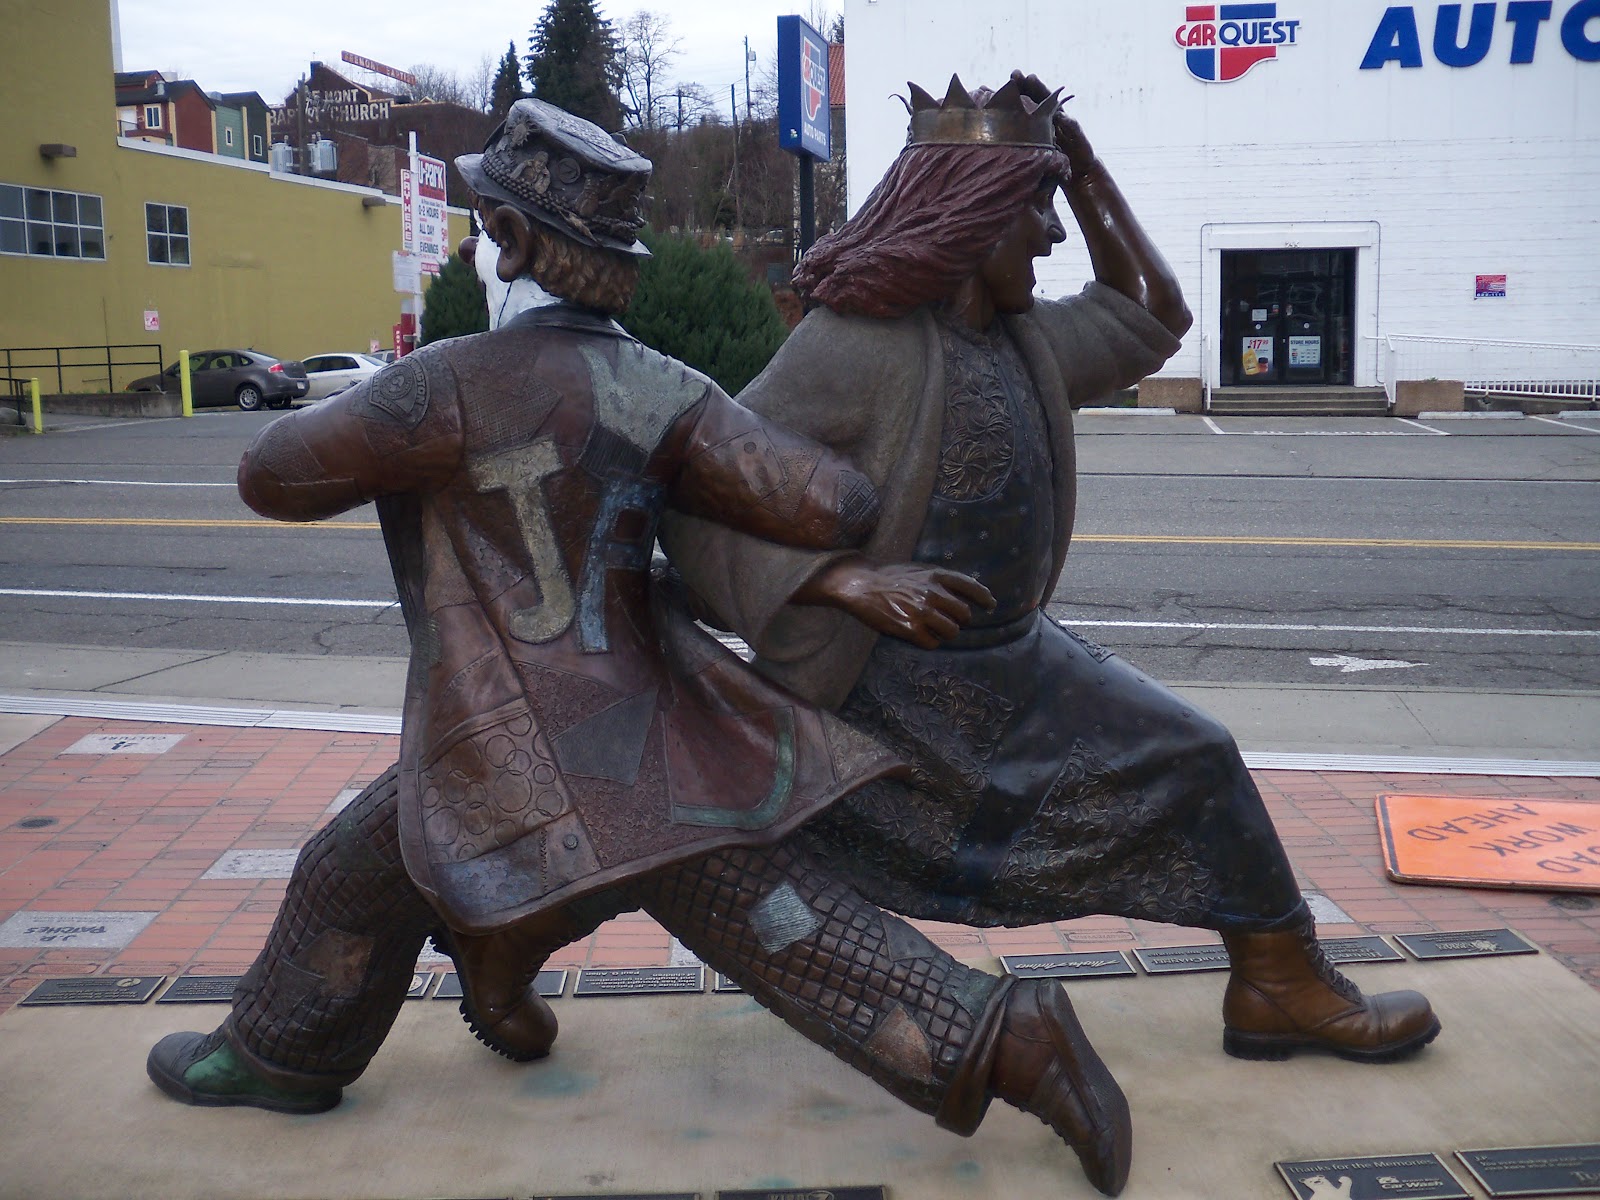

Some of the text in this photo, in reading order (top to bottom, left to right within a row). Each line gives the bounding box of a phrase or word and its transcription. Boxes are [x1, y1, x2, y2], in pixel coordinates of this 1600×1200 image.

[330, 102, 389, 121] CHURCH
[403, 171, 411, 200] PAY
[426, 207, 439, 219] HOURS
[404, 203, 412, 241] HERE
[427, 224, 435, 236] DAY
[419, 242, 439, 255] EVENINGS
[1407, 803, 1538, 841] AHEAD
[1468, 821, 1597, 857] WORK
[23, 926, 107, 935] PATCHES
[1287, 1165, 1331, 1175] Thanks
[1331, 1162, 1352, 1171] for
[1352, 1161, 1373, 1170] the
[1406, 1180, 1444, 1189] Wash
